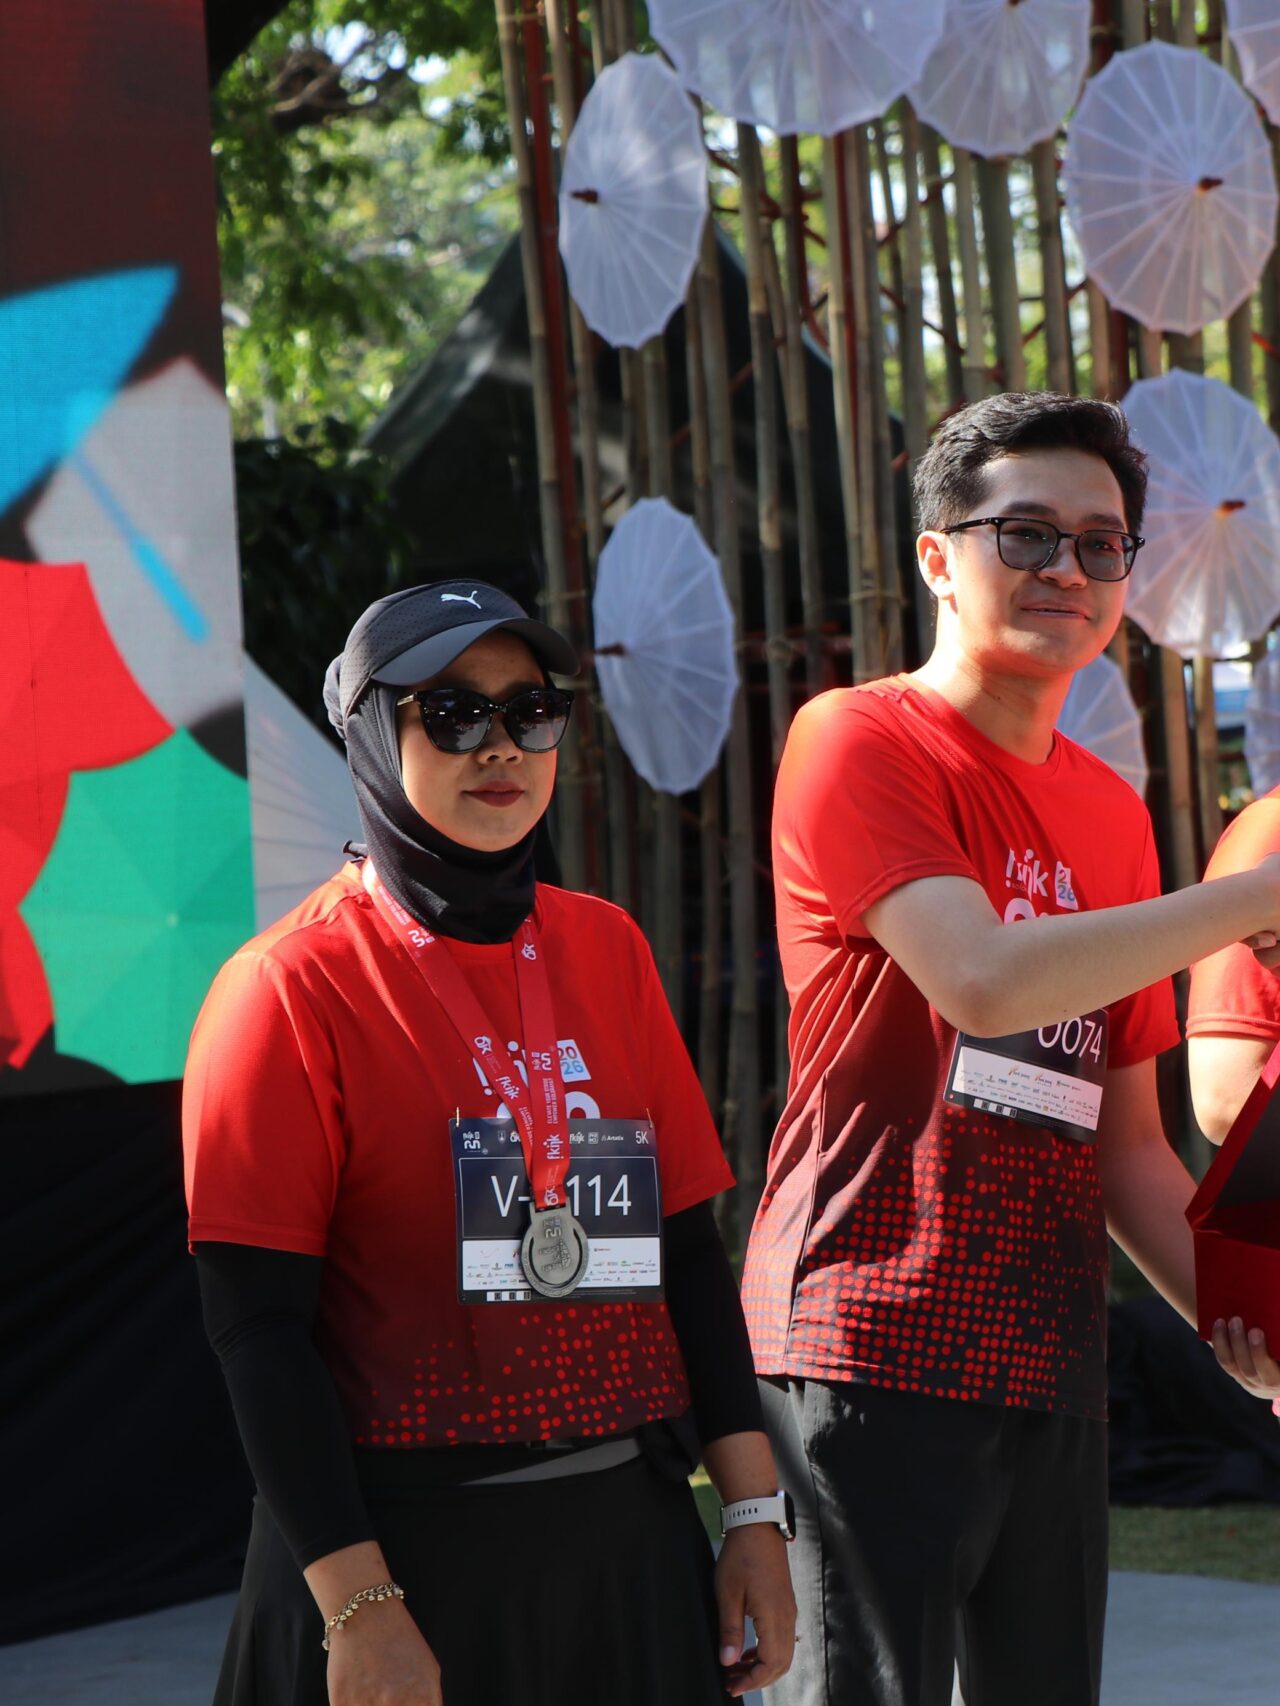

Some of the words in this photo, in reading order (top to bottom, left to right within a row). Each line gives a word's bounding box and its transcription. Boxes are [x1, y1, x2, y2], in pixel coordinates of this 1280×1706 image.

[561, 1060, 584, 1076] 26
[635, 1130, 649, 1144] 5K
[490, 1173, 632, 1218] V-114
